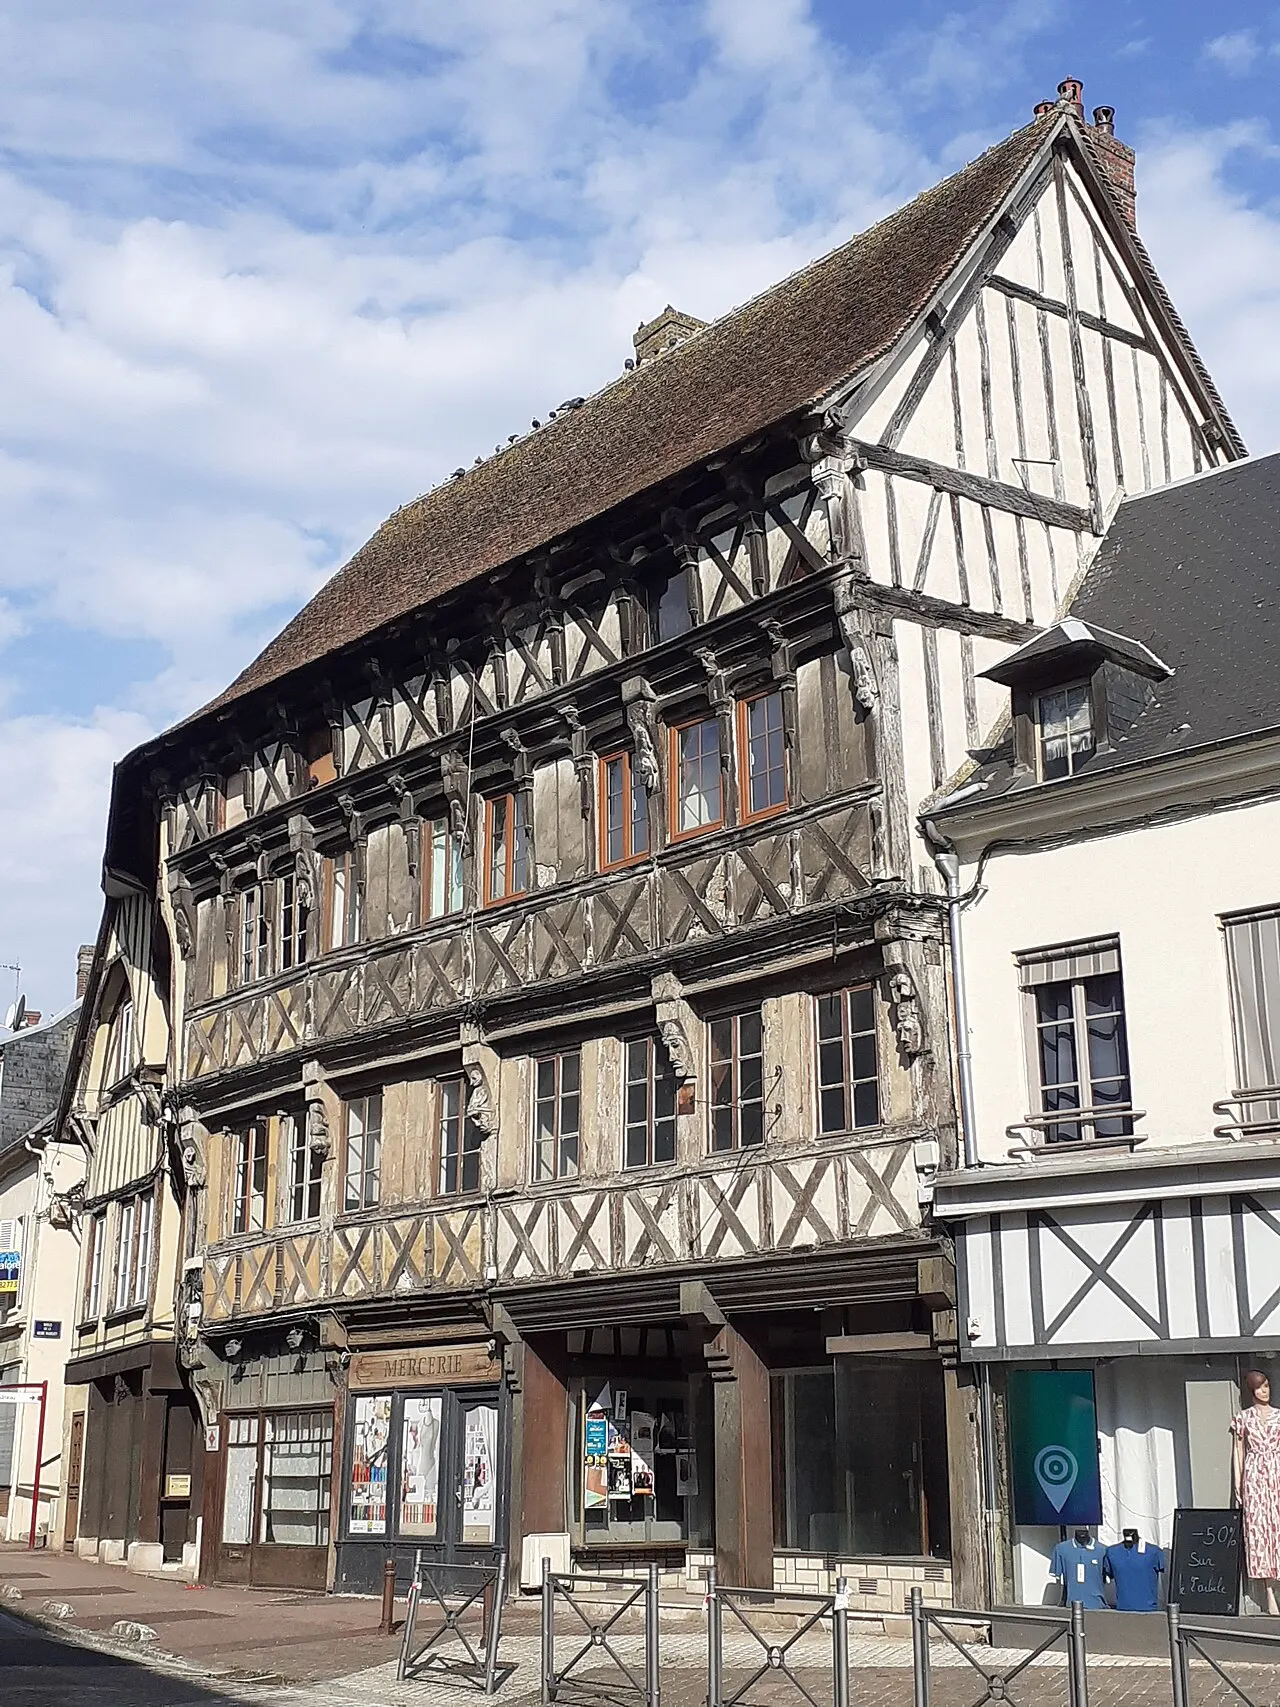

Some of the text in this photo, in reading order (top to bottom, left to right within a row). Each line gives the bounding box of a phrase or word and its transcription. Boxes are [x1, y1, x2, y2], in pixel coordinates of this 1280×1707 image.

[384, 1354, 462, 1378] MERCERIE
[1192, 1525, 1237, 1549] -50%
[1188, 1552, 1216, 1568] Sur
